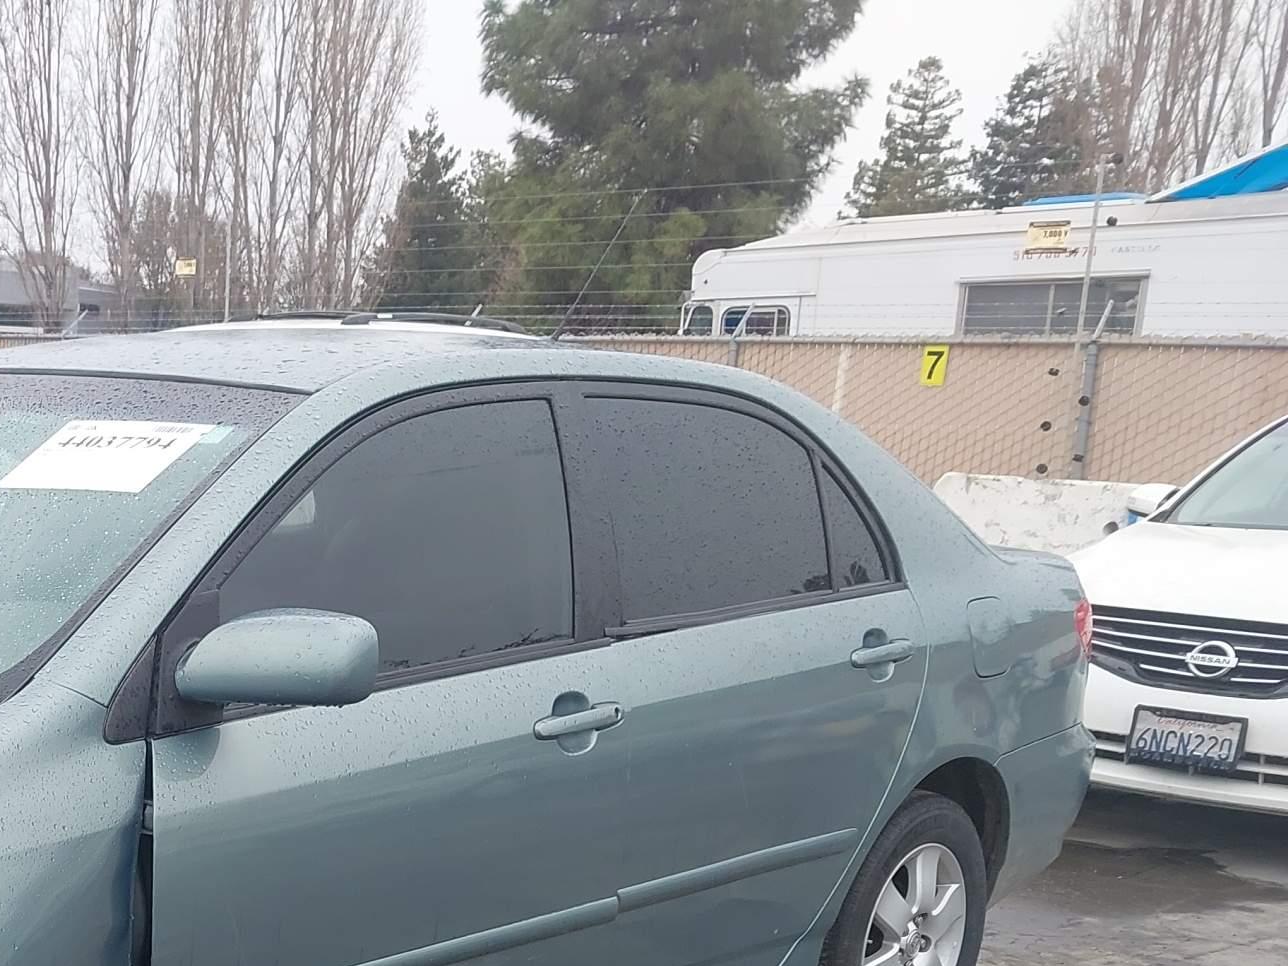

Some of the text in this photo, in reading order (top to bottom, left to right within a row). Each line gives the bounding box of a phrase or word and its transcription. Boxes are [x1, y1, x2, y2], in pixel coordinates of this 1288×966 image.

[927, 351, 945, 380] 7
[58, 435, 177, 450] 44037794
[1189, 653, 1231, 665] NISSAN
[1135, 727, 1233, 761] 6NCN220
